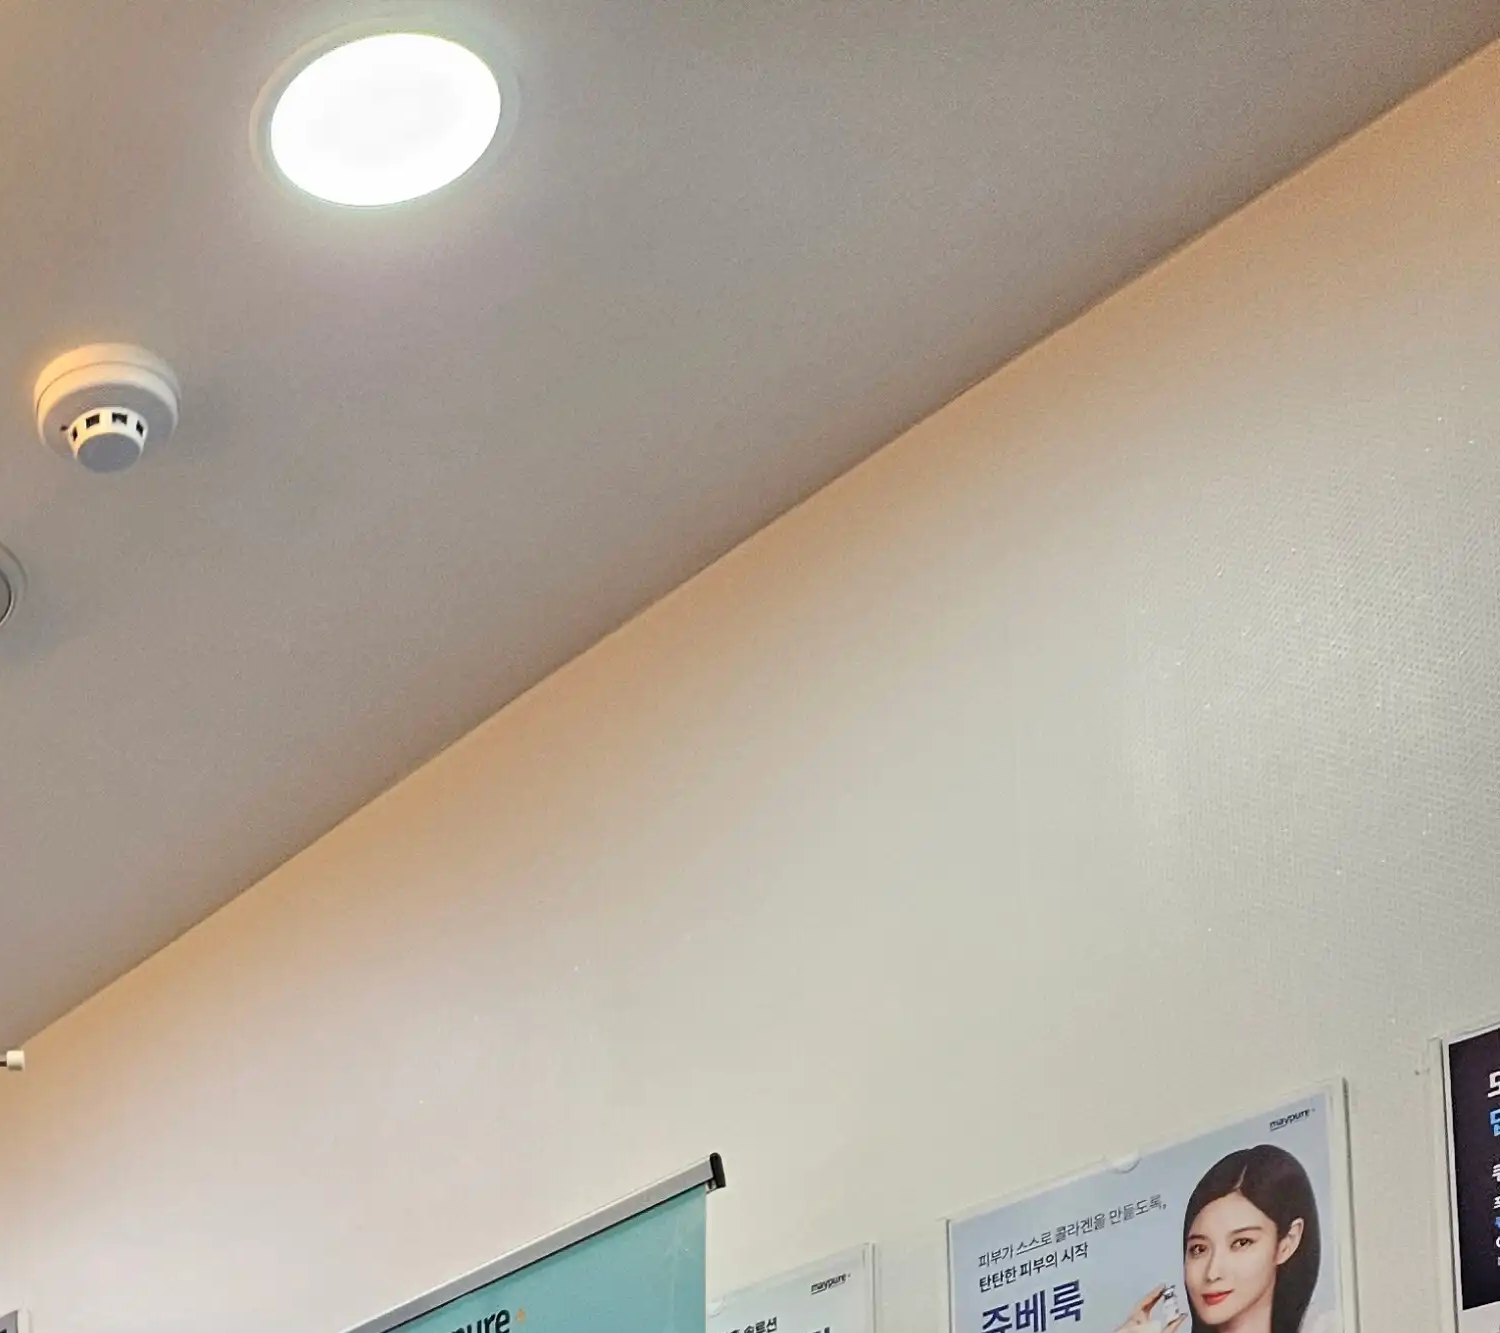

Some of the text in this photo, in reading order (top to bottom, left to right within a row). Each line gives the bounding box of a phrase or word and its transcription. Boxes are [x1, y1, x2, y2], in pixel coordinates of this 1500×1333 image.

[1269, 1108, 1310, 1132] maypure
[978, 1194, 1167, 1268] 피부가 스스로 콜라겐을 만들도록,
[810, 1273, 847, 1295] maypure
[978, 1242, 1089, 1293] 탄탄한 피부의 시작
